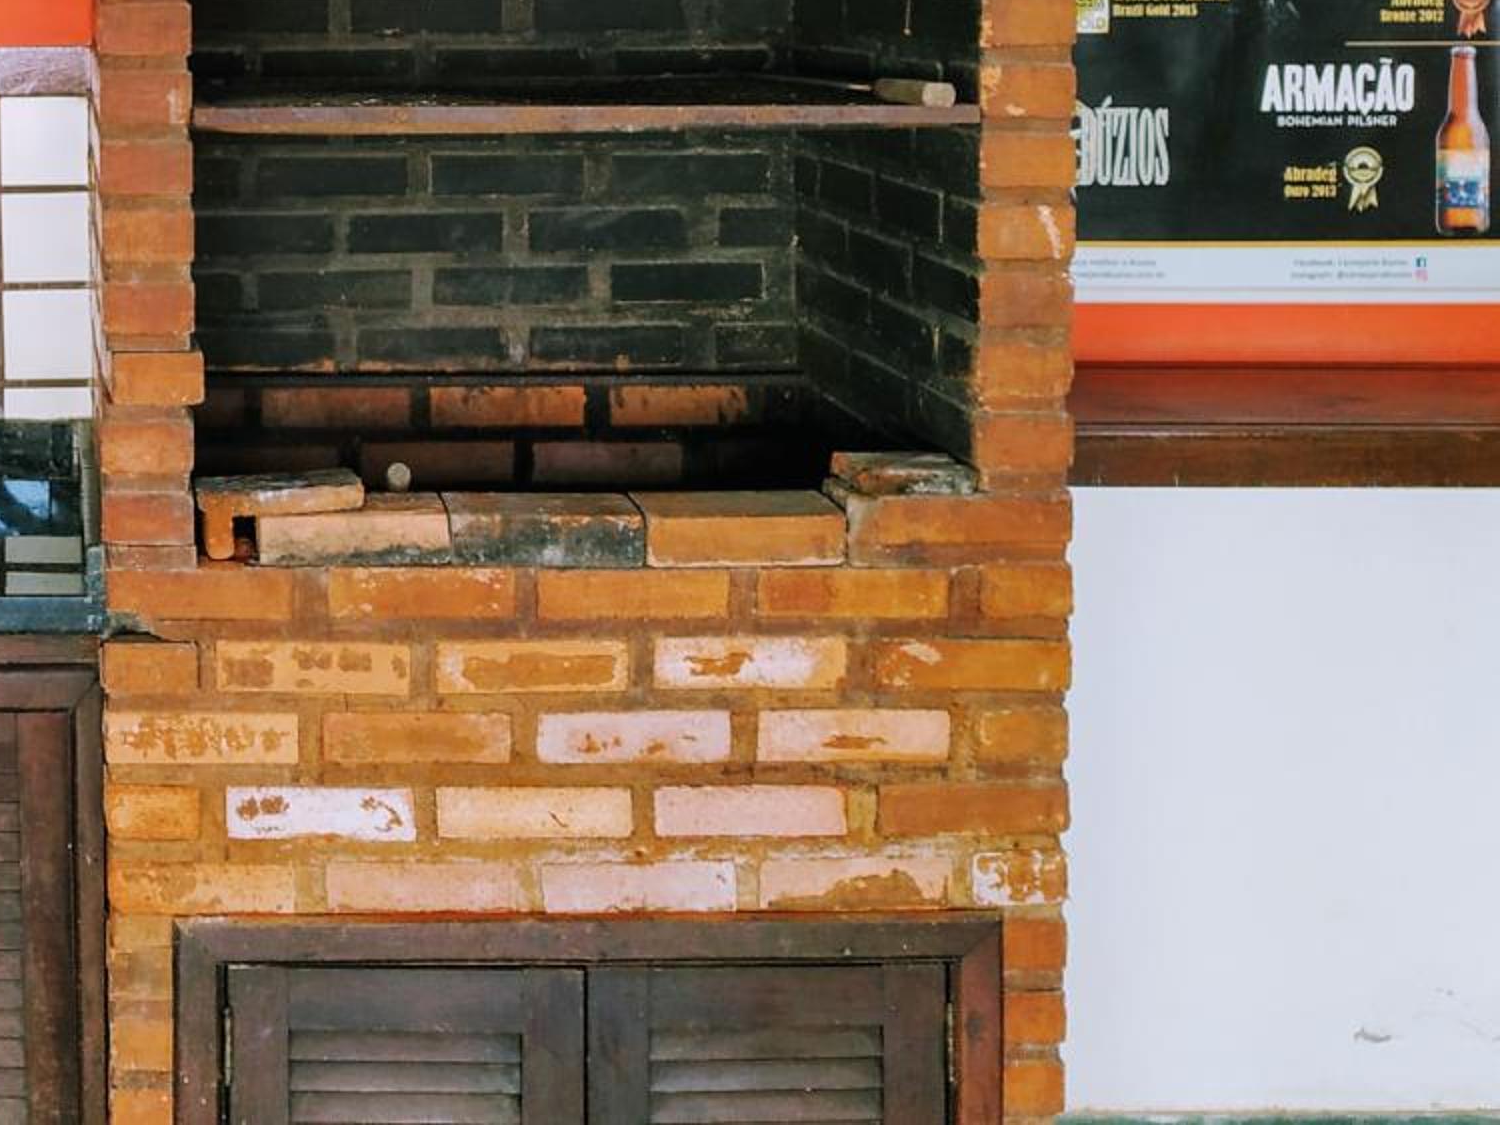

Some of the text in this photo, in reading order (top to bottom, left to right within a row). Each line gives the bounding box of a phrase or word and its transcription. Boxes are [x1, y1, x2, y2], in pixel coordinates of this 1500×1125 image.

[1260, 57, 1415, 116] ARMAÇÃO
[1277, 114, 1398, 127] BOHEMIAN PILSNER
